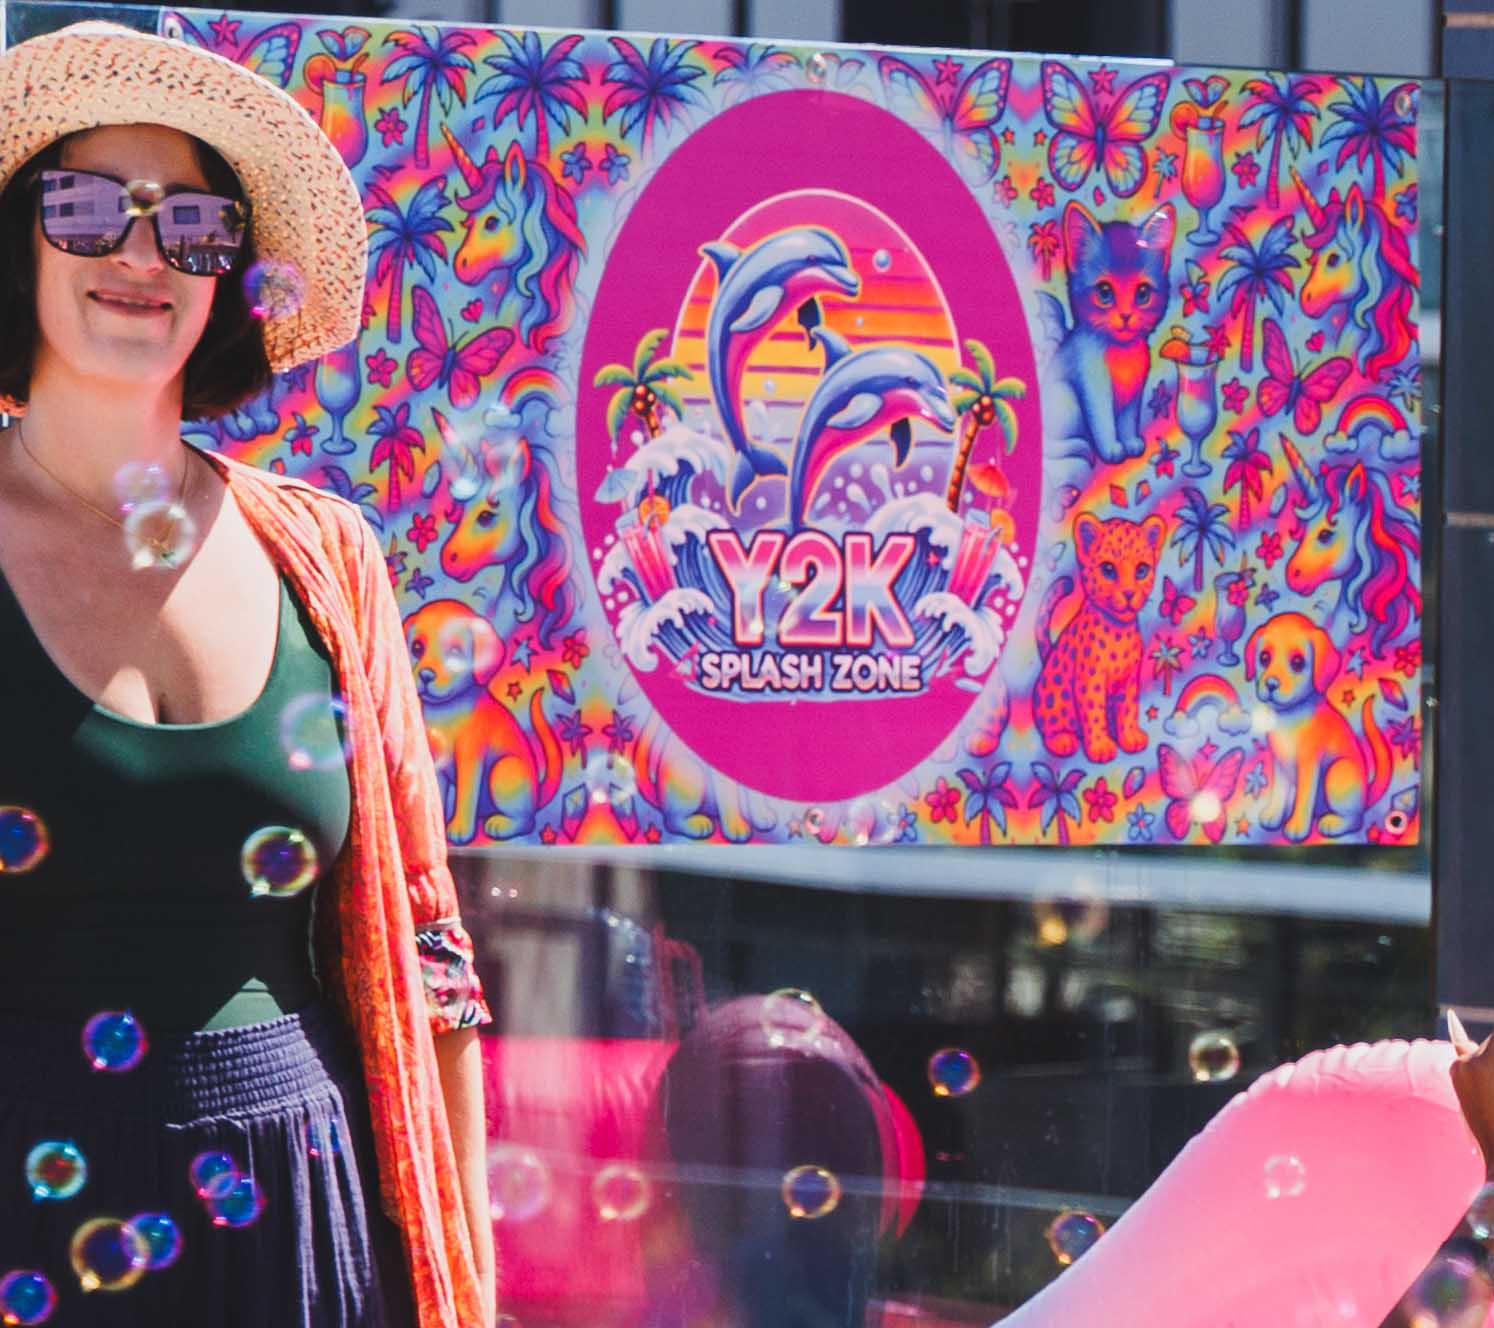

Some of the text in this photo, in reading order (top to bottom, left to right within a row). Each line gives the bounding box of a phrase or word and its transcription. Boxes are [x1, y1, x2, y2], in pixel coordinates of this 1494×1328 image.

[708, 532, 917, 649] Y2K
[701, 651, 923, 691] SPLASH ZONE
